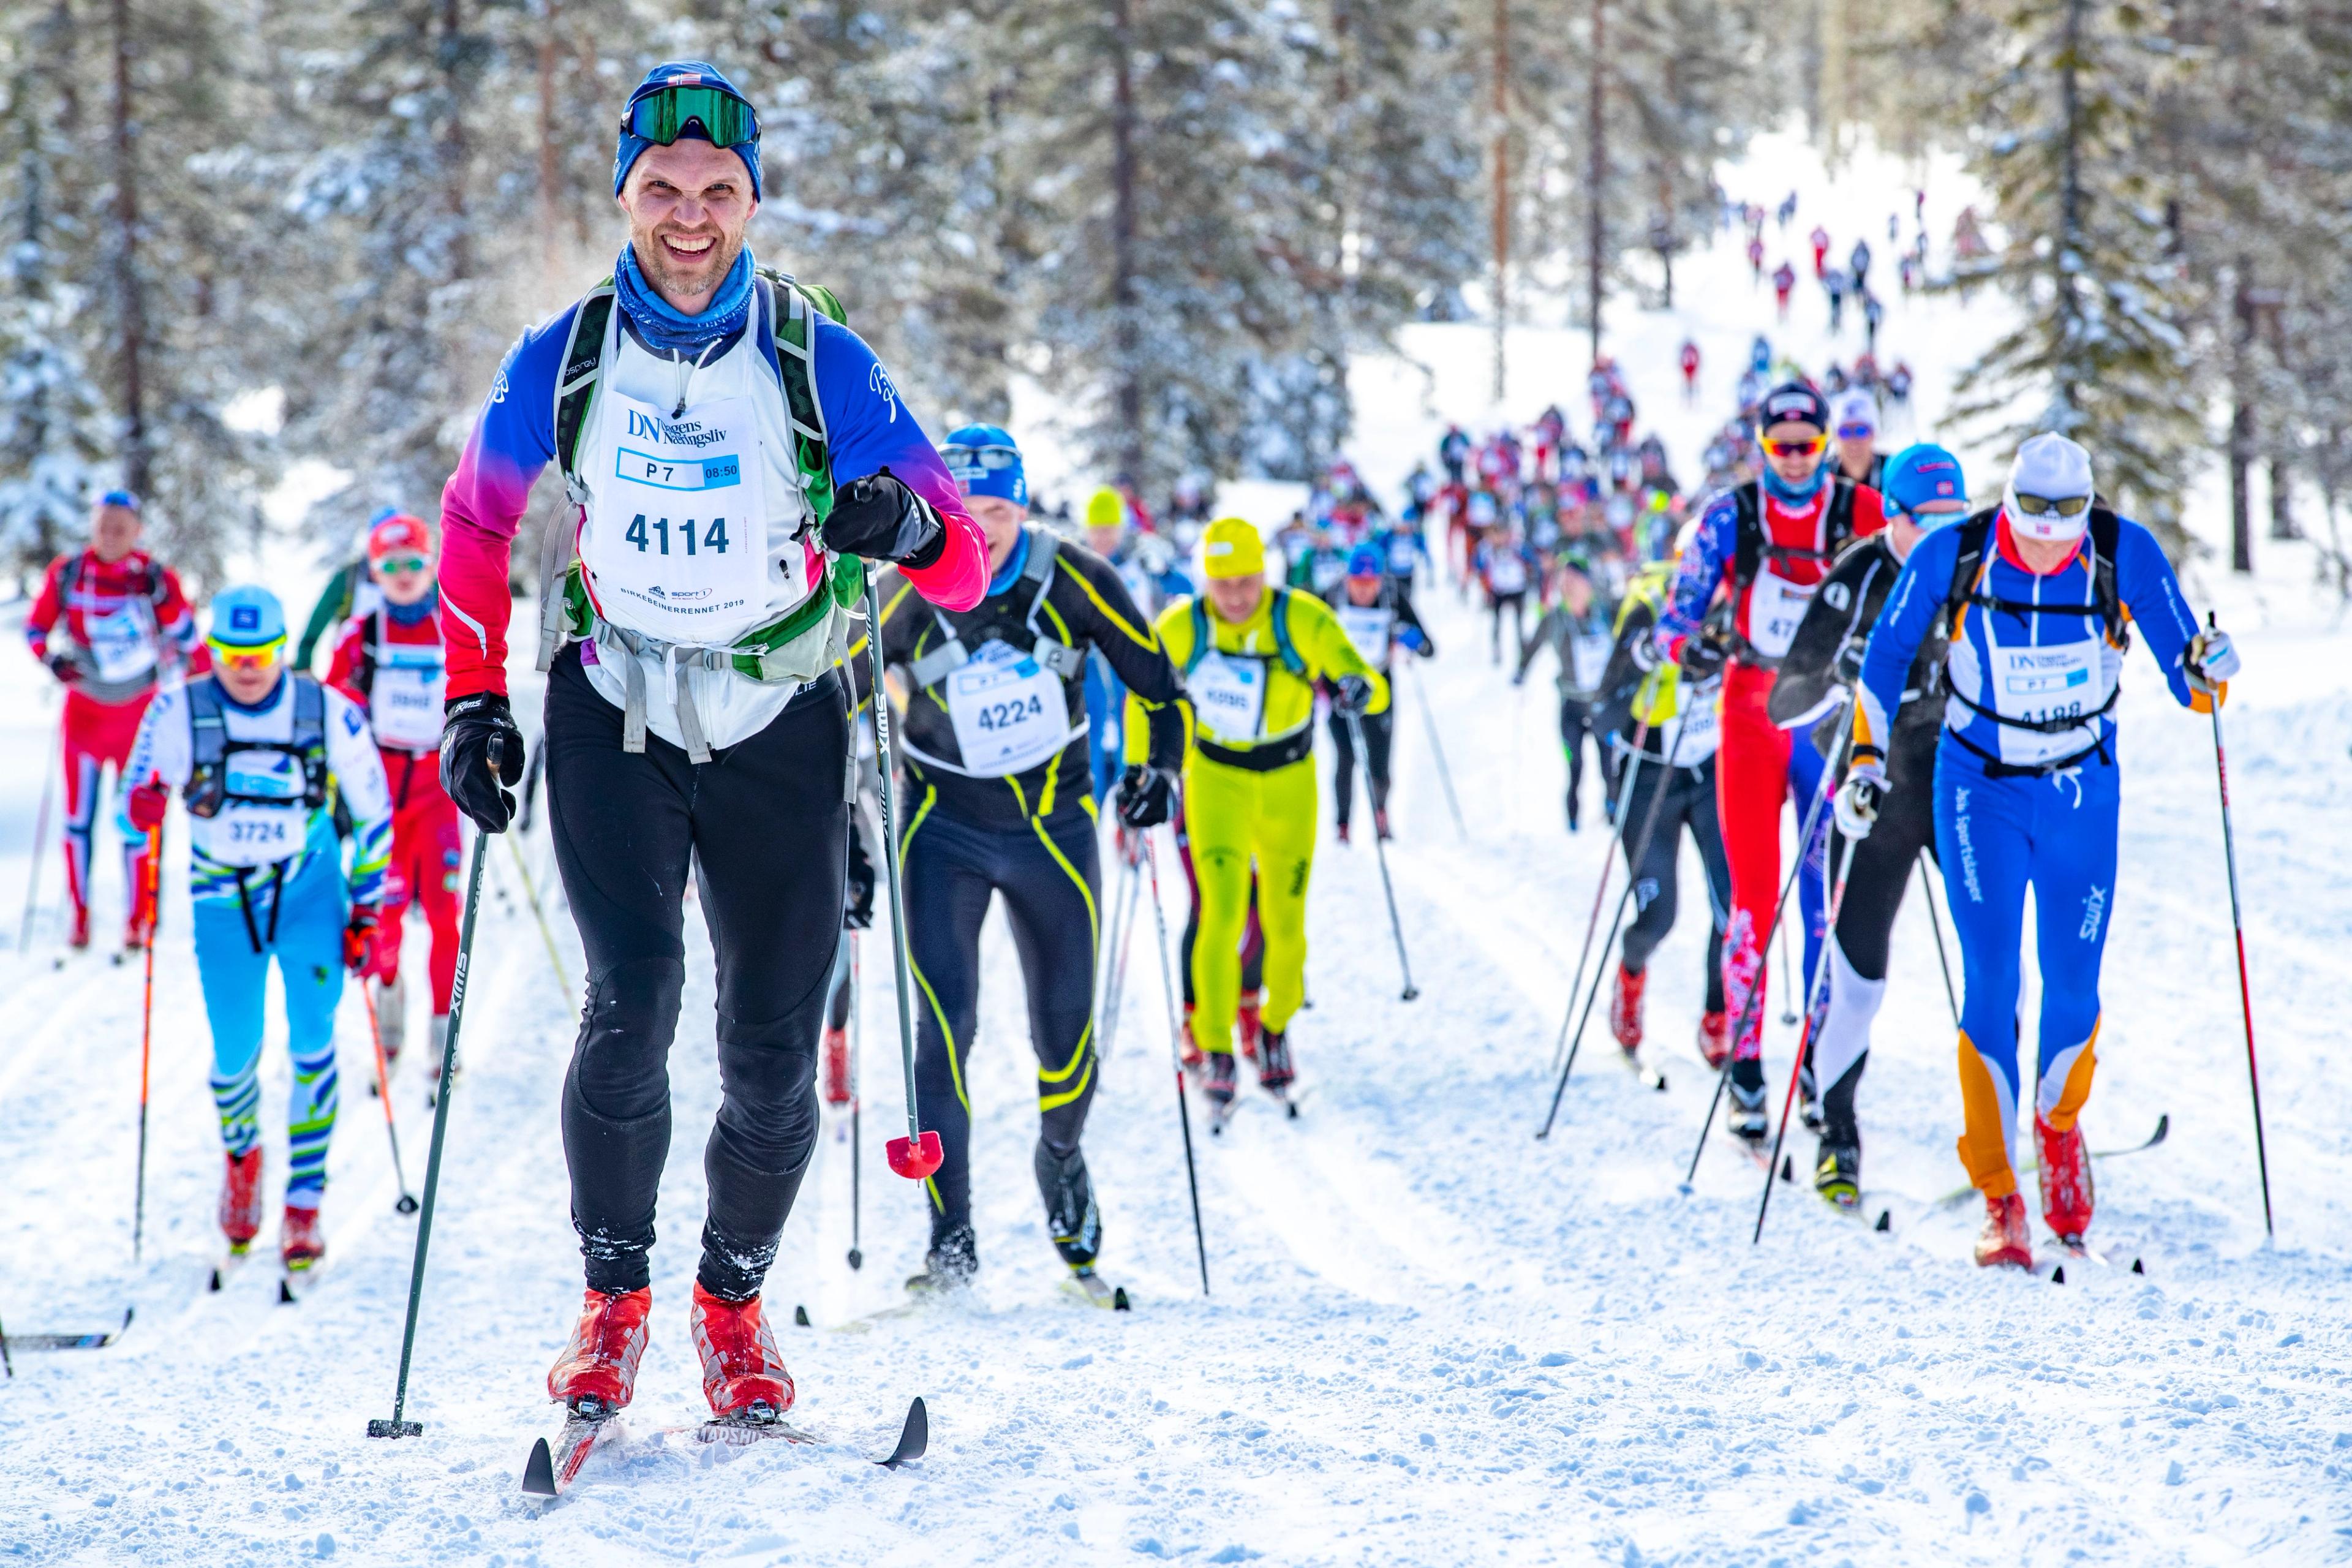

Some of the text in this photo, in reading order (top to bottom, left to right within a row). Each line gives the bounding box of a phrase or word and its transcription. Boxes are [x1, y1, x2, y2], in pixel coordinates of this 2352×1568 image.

[565, 357, 596, 376] osprey
[628, 409, 660, 443] DN
[663, 429, 726, 448] Næringsliv
[646, 462, 737, 481] P 7 08:50
[625, 513, 729, 556] 4114
[620, 588, 744, 614] BIRKEBEINERRENNET 2019
[979, 695, 1042, 731] 4224
[229, 821, 285, 842] 3724
